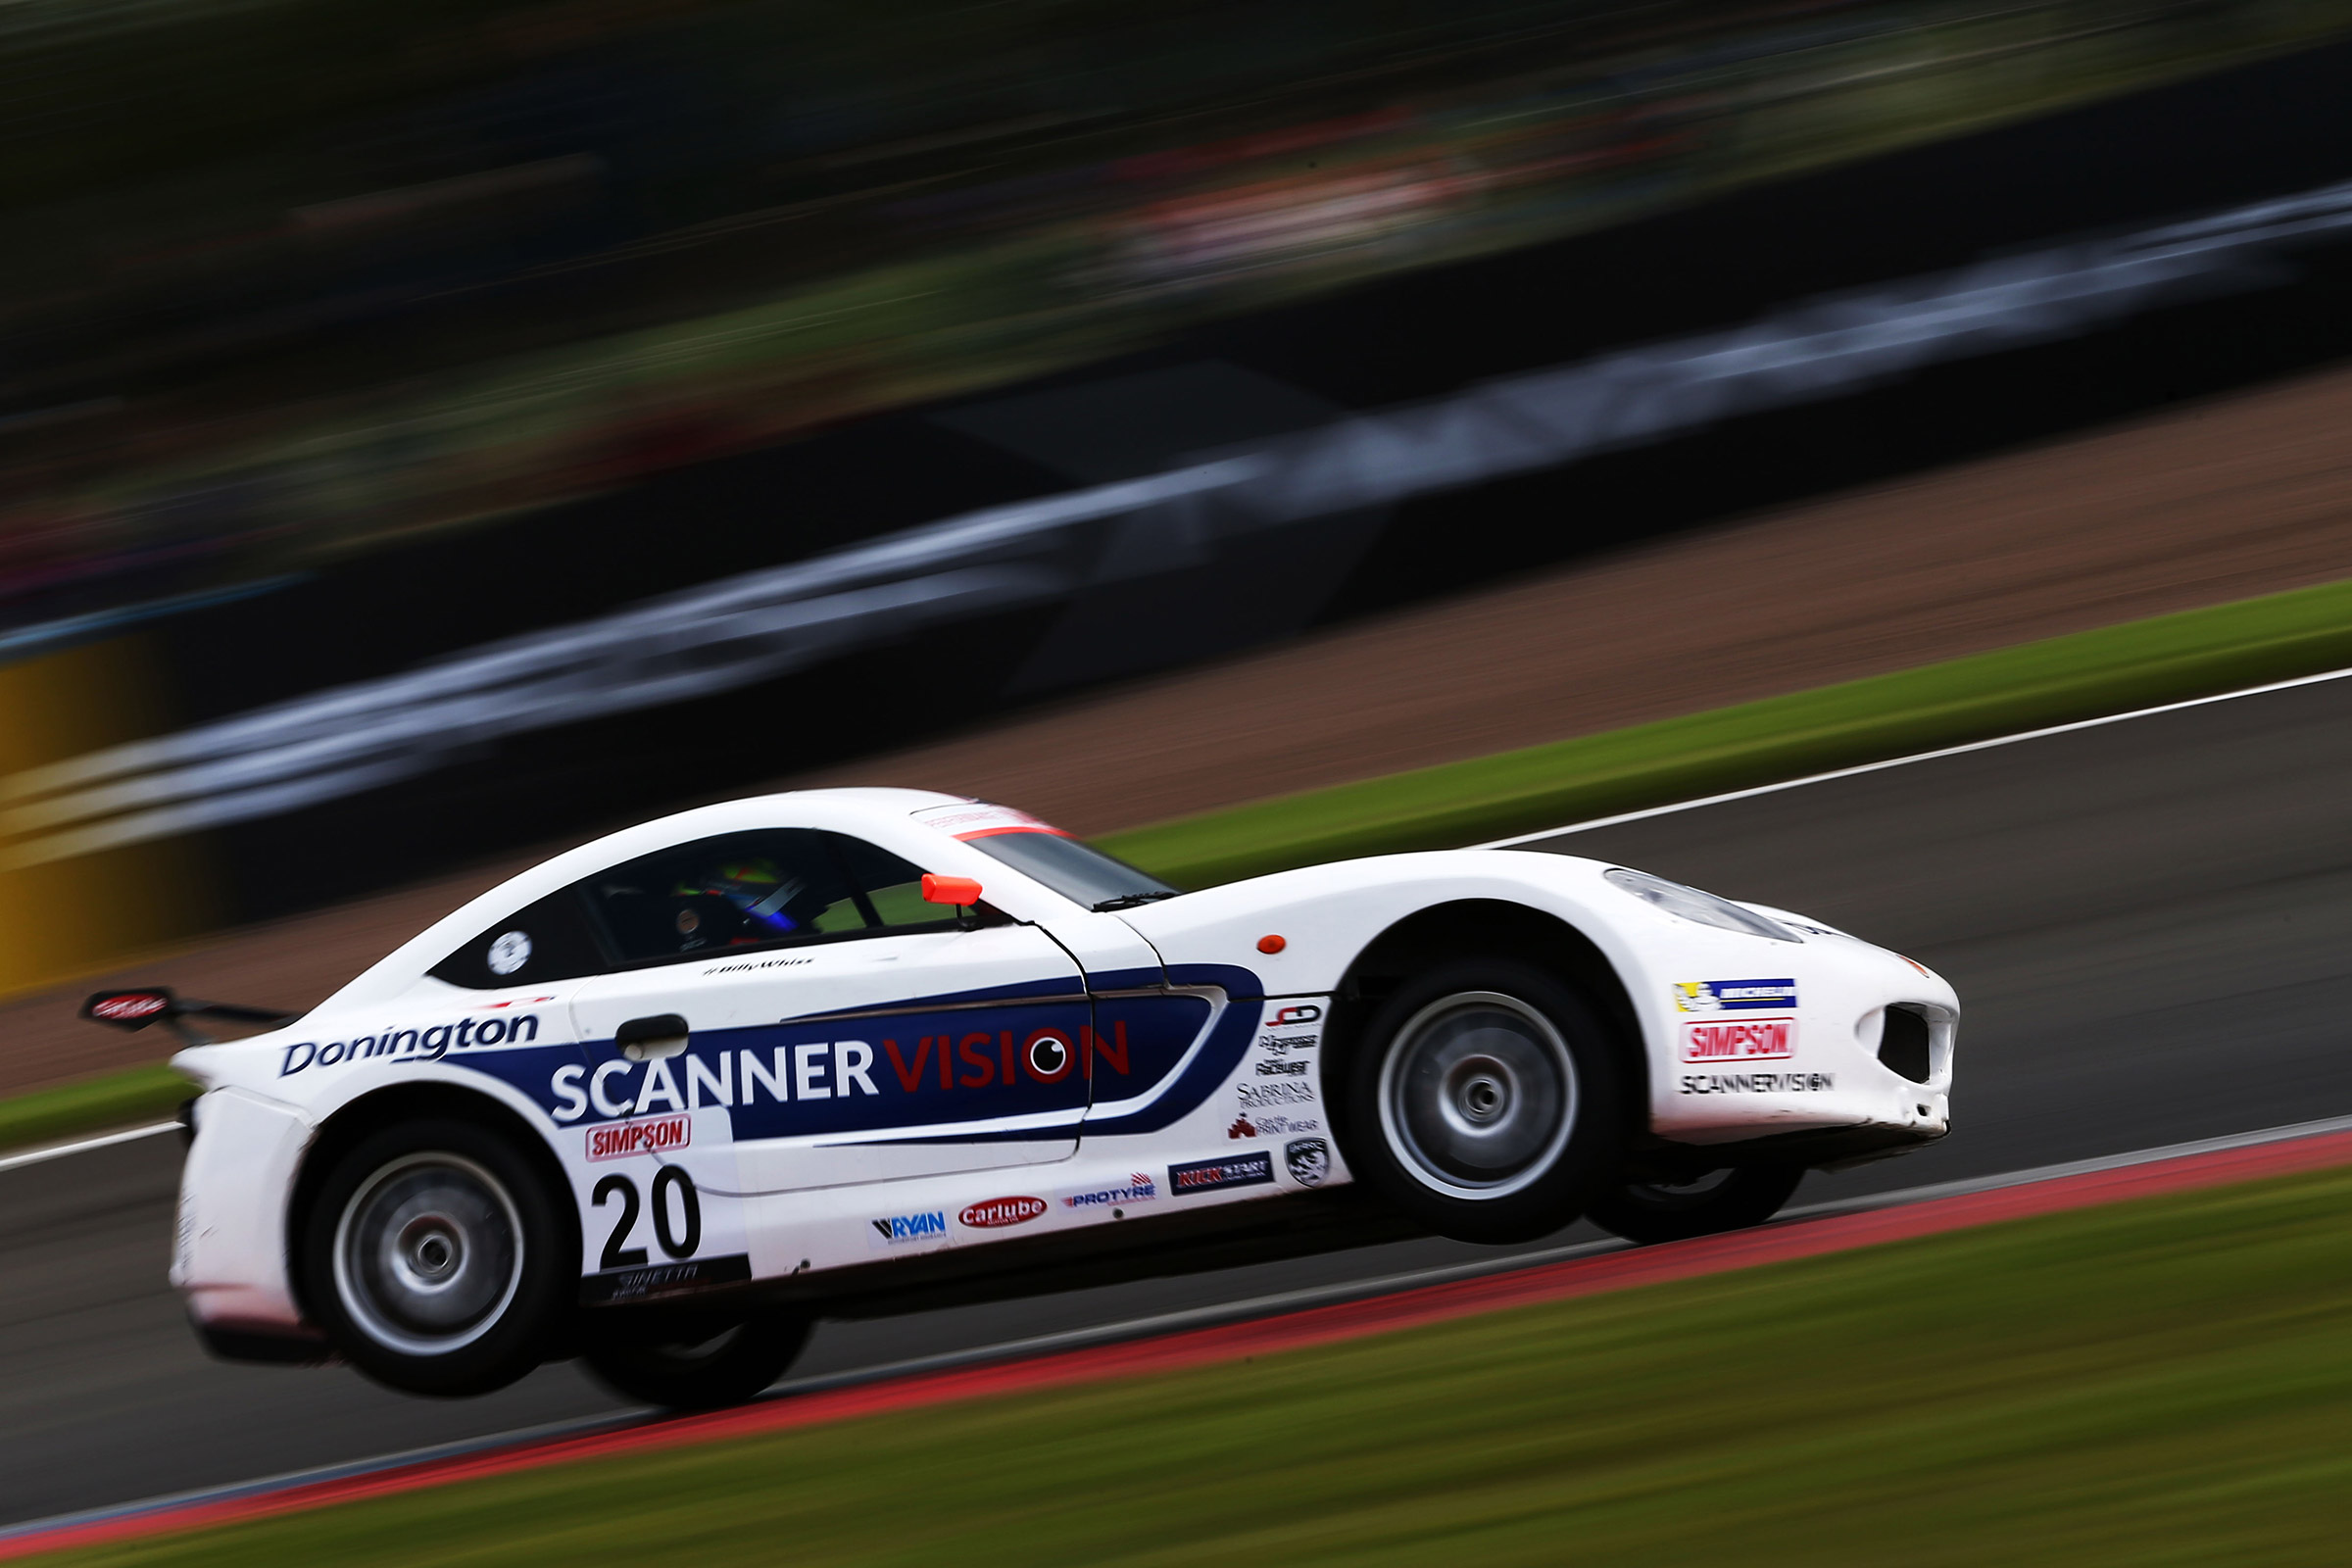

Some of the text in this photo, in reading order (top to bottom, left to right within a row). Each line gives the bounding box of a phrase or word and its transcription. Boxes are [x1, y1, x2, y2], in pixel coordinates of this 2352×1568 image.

[280, 1013, 540, 1078] Donington
[1689, 1023, 1792, 1057] SIMPSON
[591, 1121, 683, 1157] SIMPSON
[1072, 1184, 1155, 1207] PROTYRE
[591, 1164, 702, 1271] 20
